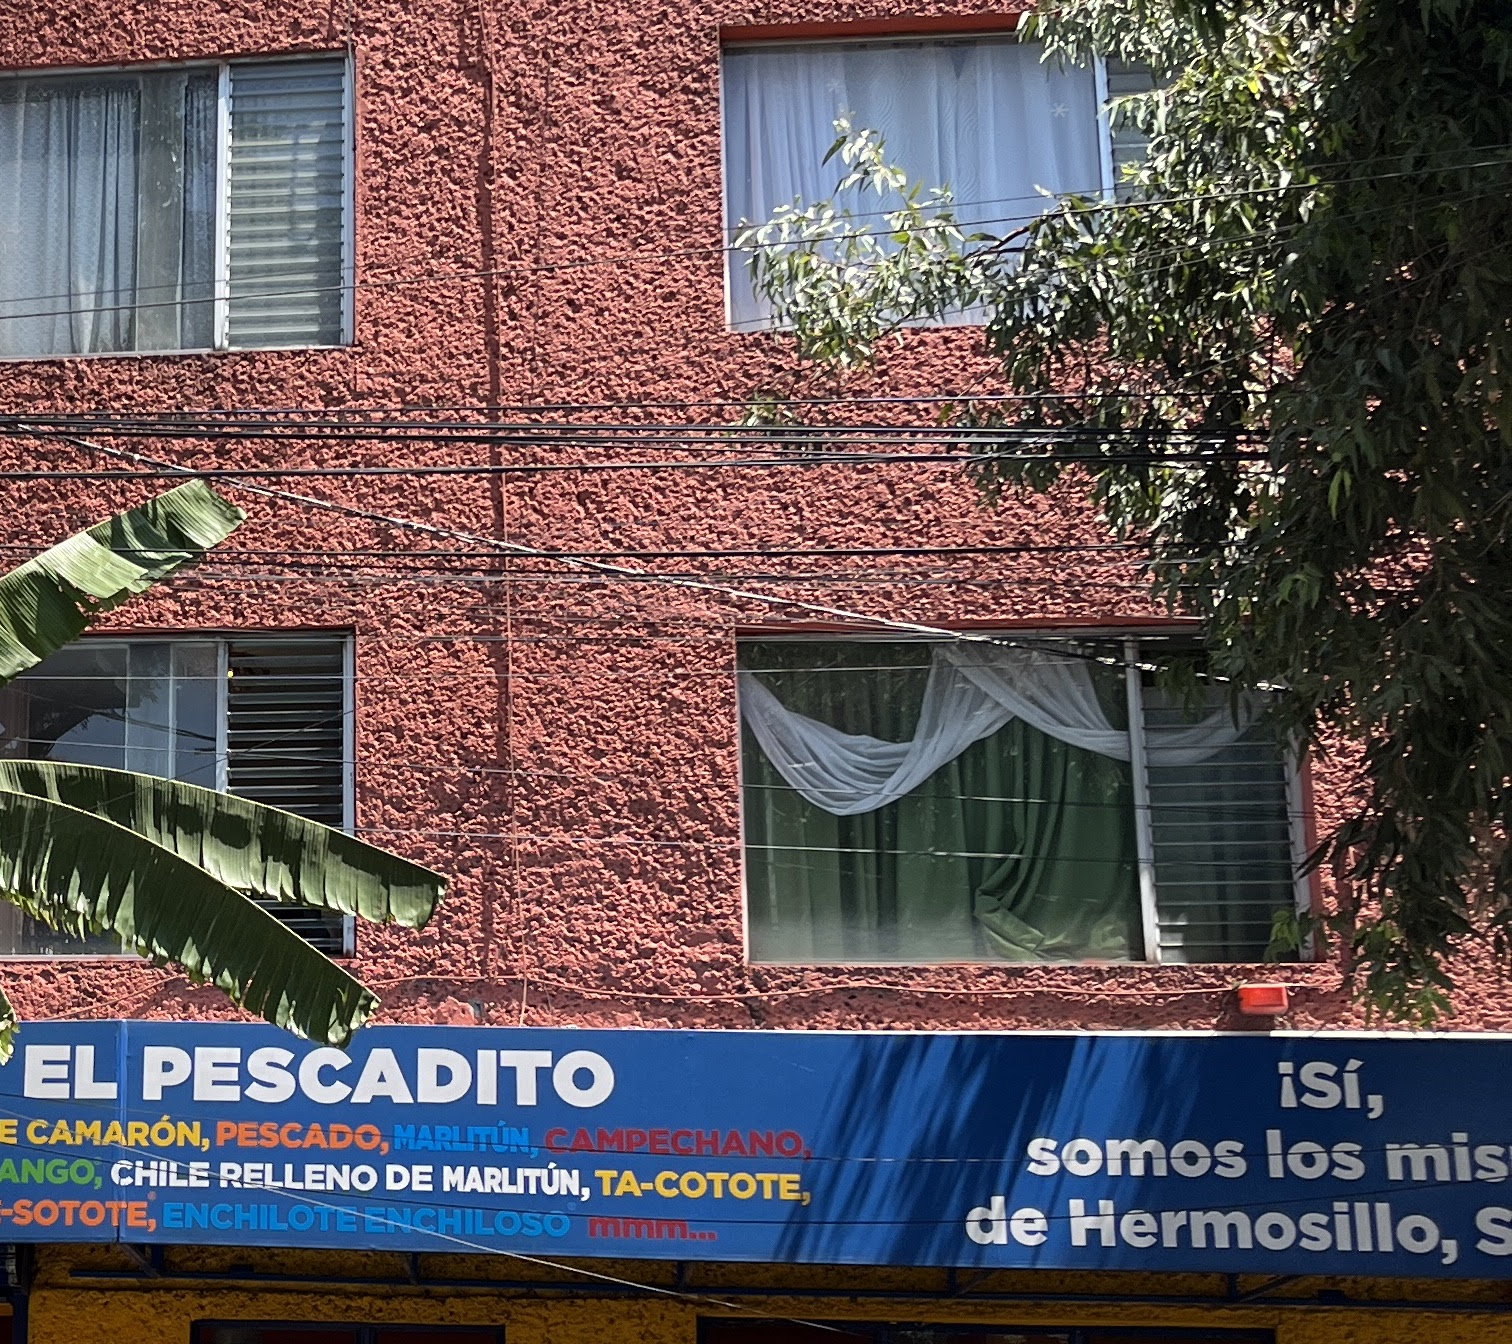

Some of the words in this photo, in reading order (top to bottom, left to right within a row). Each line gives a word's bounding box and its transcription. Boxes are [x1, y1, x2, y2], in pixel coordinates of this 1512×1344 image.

[23, 1044, 118, 1100] EL
[142, 1045, 615, 1108] PESCADITO
[1277, 1058, 1385, 1120] ¡Sí,
[26, 1115, 210, 1152] CAMARÓN,
[215, 1121, 389, 1156] PESCADO,
[394, 1119, 539, 1159] MARLITÚN,
[544, 1127, 813, 1161] CAMPECHANO,
[1025, 1136, 1248, 1179] somos
[1264, 1129, 1366, 1181] los
[1385, 1131, 1512, 1183] mis
[110, 1159, 211, 1188] CHILE
[219, 1162, 378, 1191] RELLENO
[386, 1165, 433, 1193] DE
[442, 1162, 591, 1202] MARLITÚN,
[594, 1169, 811, 1206] TA-COTOTE,
[162, 1203, 357, 1233] ENCHILOTE
[366, 1206, 571, 1239] ENCHILOSO
[589, 1216, 718, 1241] mmm...
[965, 1195, 1048, 1247] de
[1068, 1198, 1459, 1265] Hermosillo,
[1475, 1206, 1512, 1256] S
